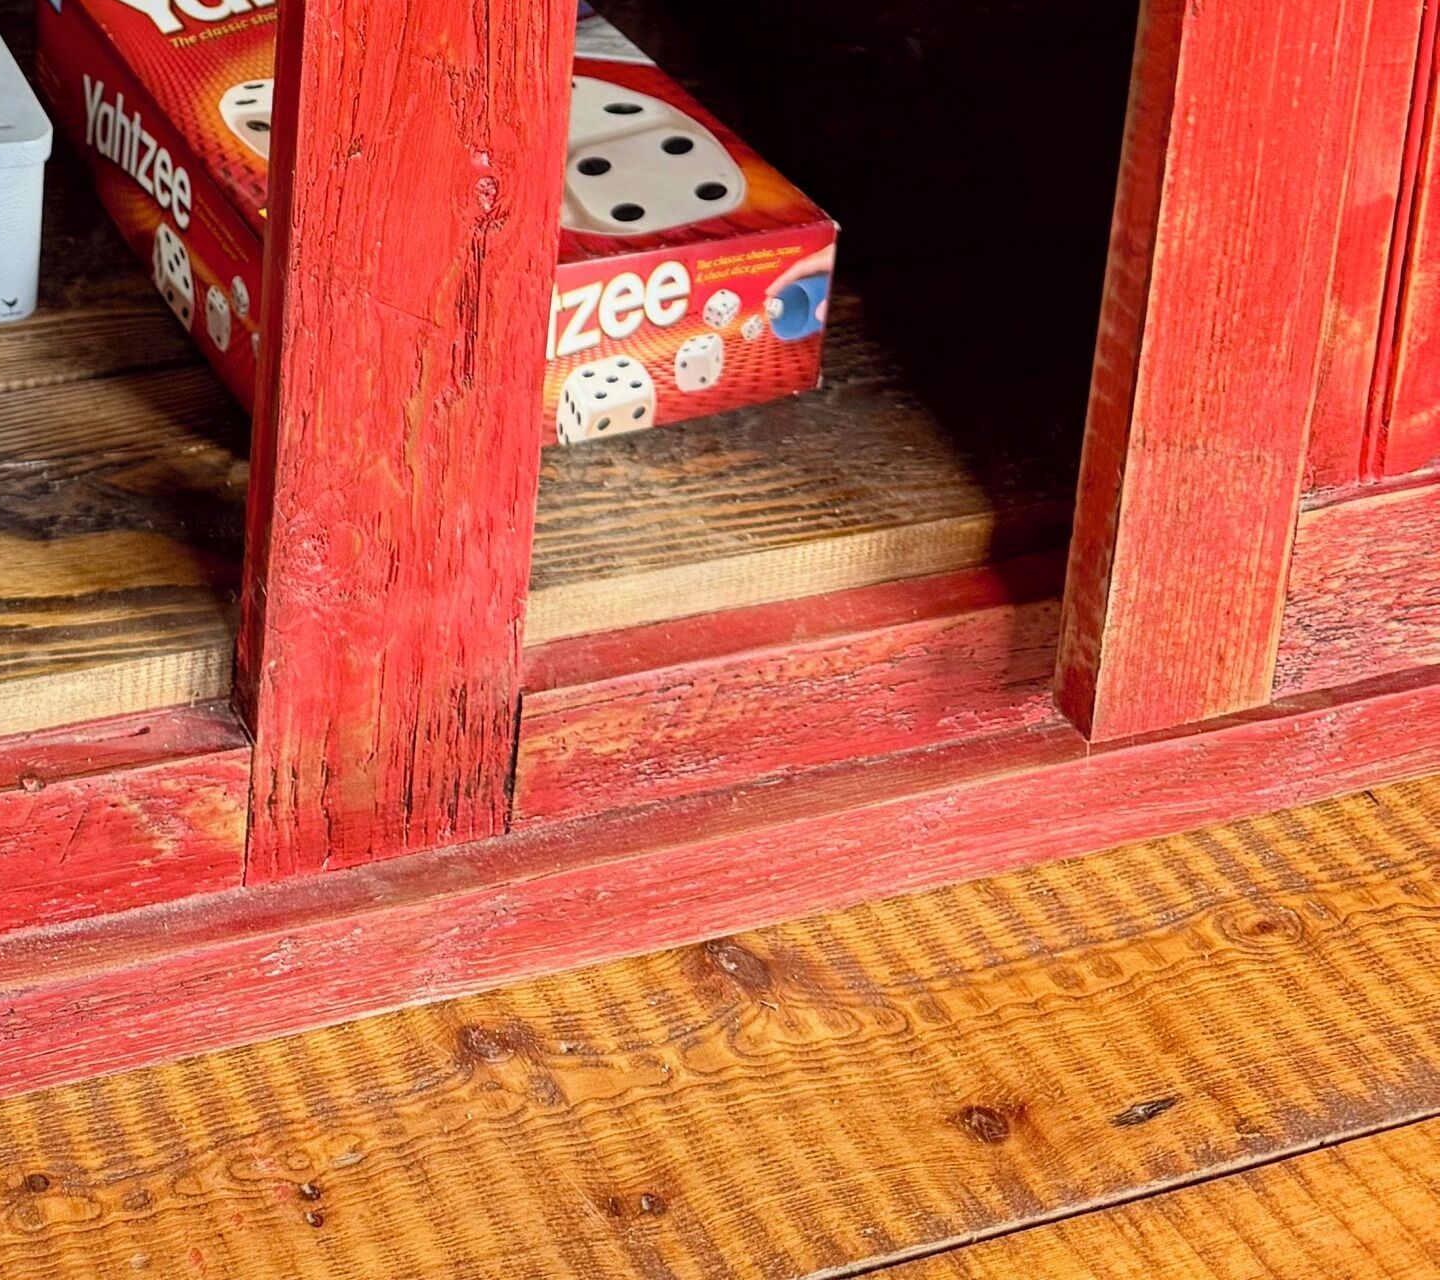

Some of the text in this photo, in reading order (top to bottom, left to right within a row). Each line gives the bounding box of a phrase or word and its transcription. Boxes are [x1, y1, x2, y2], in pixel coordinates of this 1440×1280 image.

[171, 12, 278, 49] The classic sha
[83, 73, 191, 230] Yahtzee
[697, 259, 712, 269] The
[713, 254, 745, 266] classic
[704, 268, 730, 280] shout
[731, 266, 750, 275] dice
